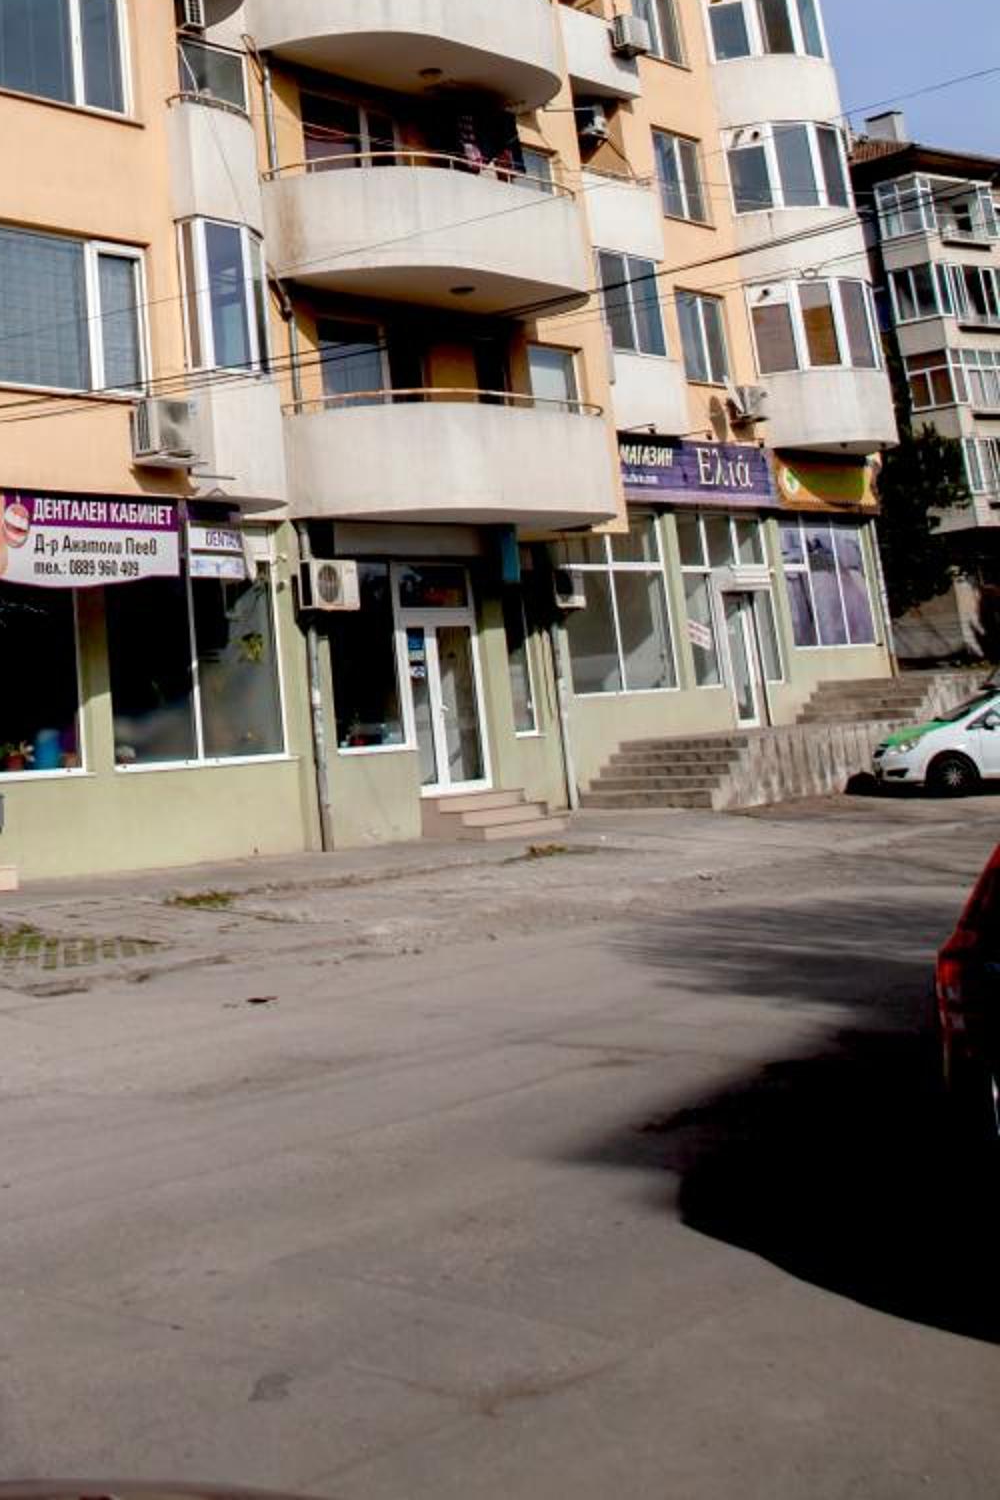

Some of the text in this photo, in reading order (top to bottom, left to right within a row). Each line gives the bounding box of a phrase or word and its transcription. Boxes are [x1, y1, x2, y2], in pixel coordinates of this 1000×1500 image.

[33, 498, 173, 526] ДЕНТАЛЕН КАБИНЕТ
[34, 533, 59, 556] Д-р
